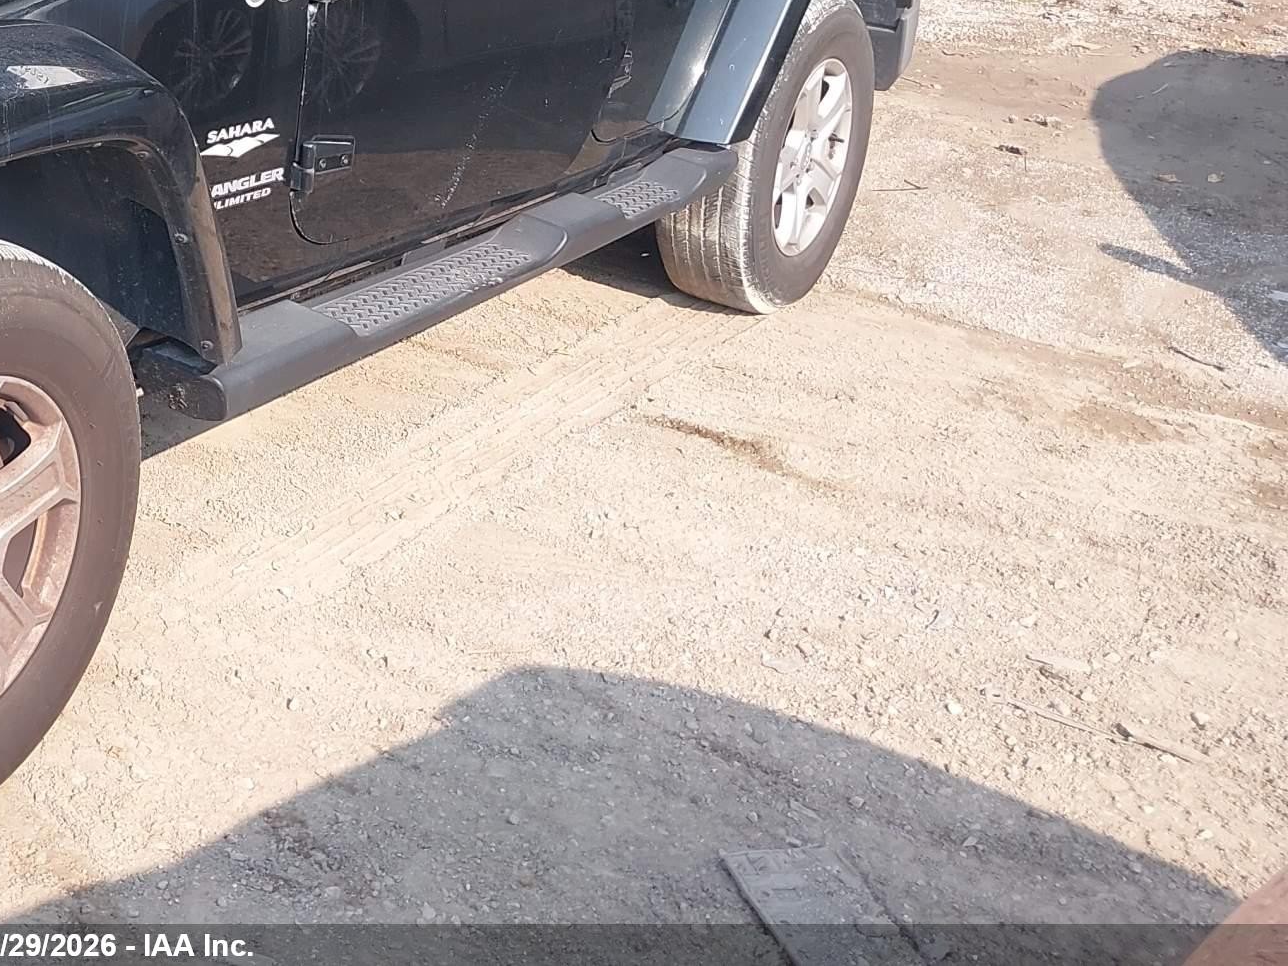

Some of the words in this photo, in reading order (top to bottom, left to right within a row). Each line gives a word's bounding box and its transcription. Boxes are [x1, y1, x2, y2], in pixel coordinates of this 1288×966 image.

[206, 117, 275, 144] SAHARA
[210, 167, 285, 198] ANGLER
[213, 187, 272, 211] LIMITED
